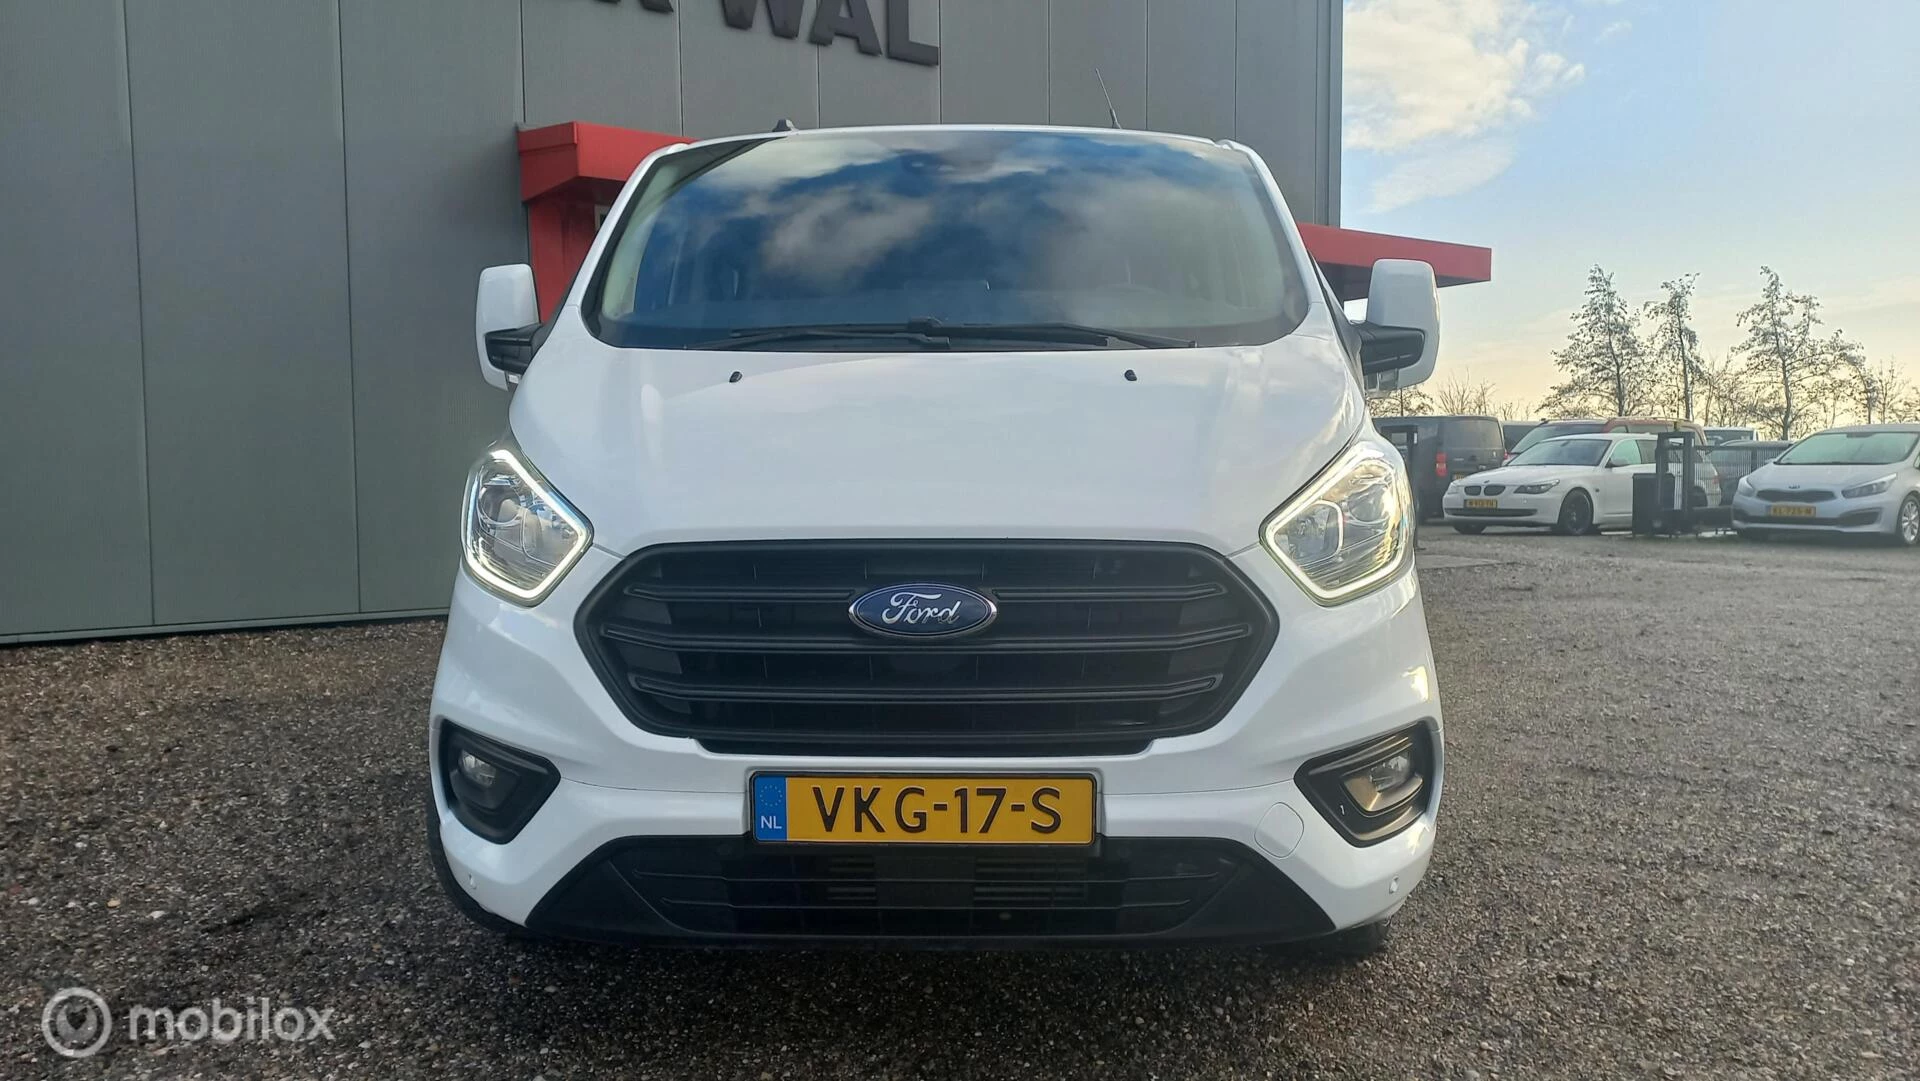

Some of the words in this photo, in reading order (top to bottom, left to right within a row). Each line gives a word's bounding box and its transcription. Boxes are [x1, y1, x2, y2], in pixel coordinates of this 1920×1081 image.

[881, 591, 962, 625] Ford
[760, 815, 782, 830] NL
[811, 786, 1062, 835] VKG-17-S
